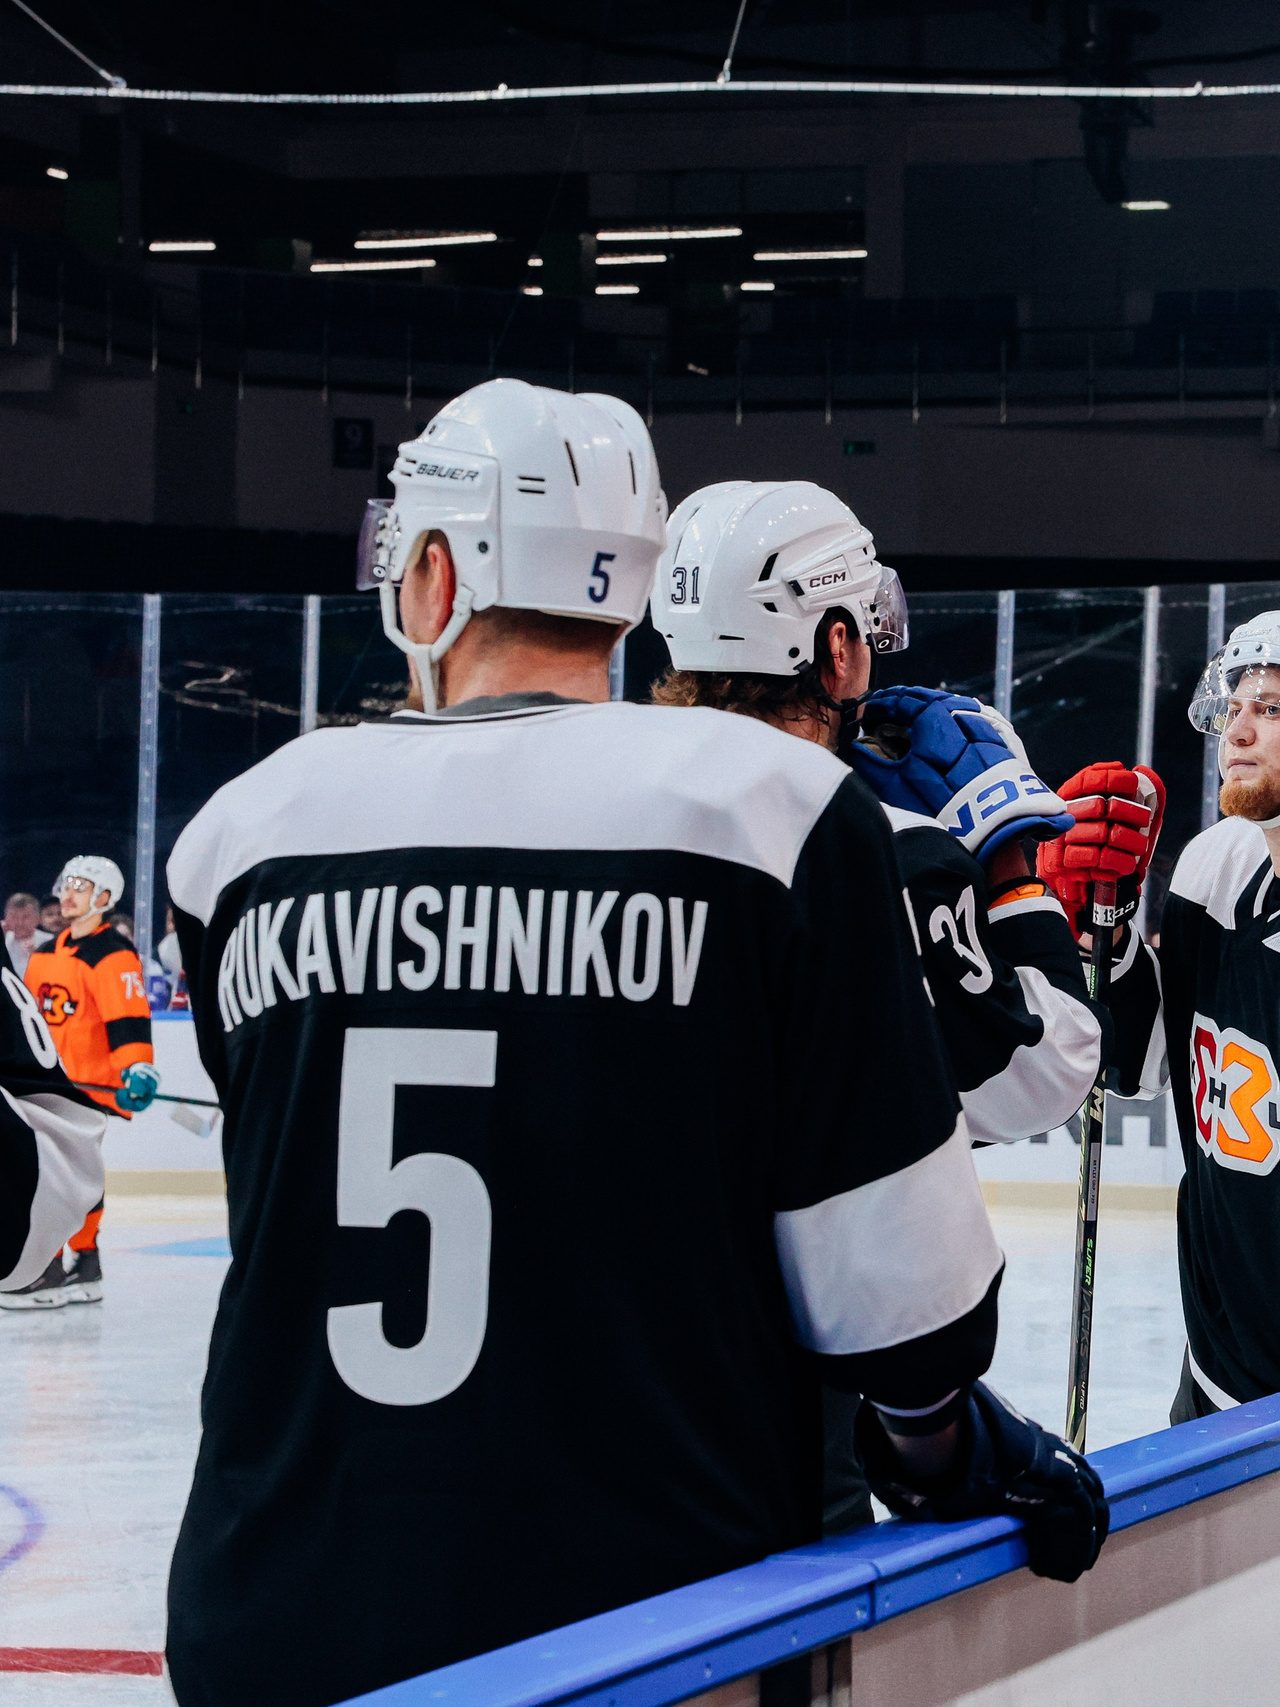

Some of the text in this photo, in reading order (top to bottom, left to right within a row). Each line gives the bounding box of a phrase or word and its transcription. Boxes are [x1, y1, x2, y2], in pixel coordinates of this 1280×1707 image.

[416, 463, 480, 481] BAUER
[588, 551, 617, 603] 5
[671, 565, 700, 604] 31
[809, 571, 846, 588] CCM
[218, 885, 709, 1033] RUKAVISHNIKOV
[1, 966, 58, 1070] 8
[327, 1027, 498, 1406] 5
[1085, 1238, 1094, 1286] SUPER
